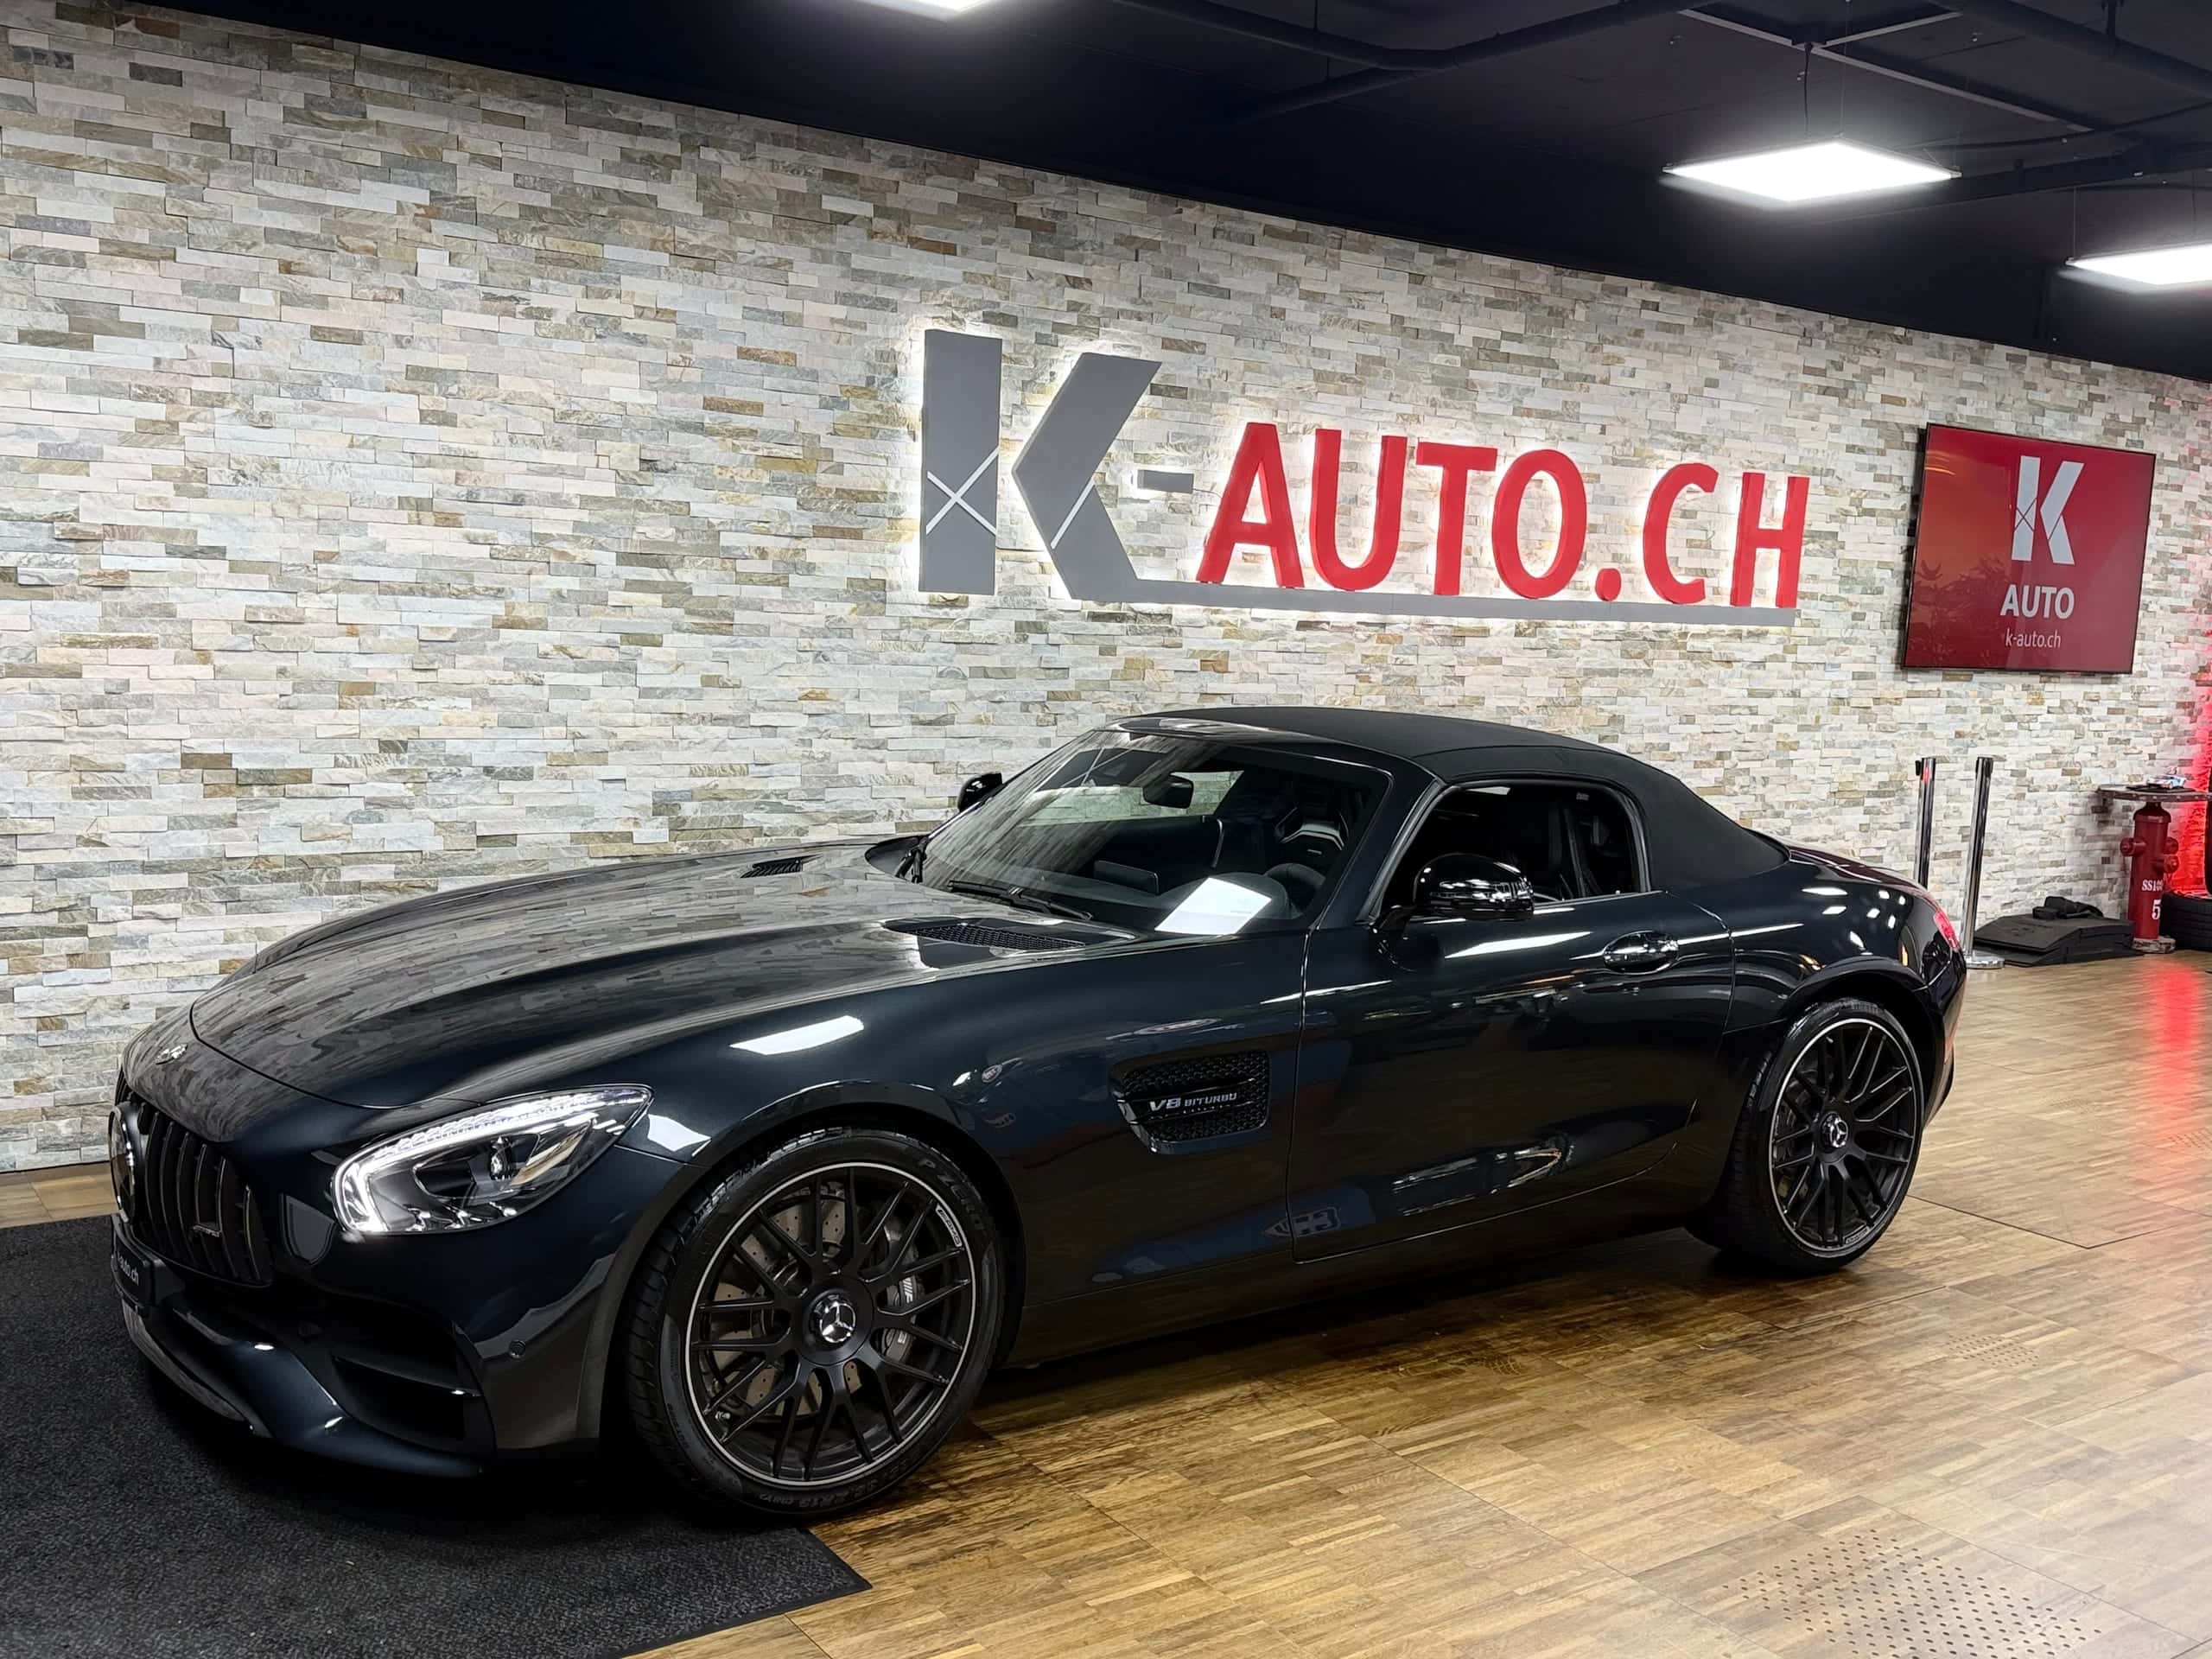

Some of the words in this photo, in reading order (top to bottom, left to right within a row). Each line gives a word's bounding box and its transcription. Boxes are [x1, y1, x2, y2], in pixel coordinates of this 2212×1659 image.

[918, 328, 1810, 609] K-AUTO.CH
[2012, 455, 2085, 566] K
[1999, 583, 2075, 620] AUTO
[2005, 627, 2062, 648] k-auto.ch
[1148, 1096, 1182, 1112] V8
[1184, 1092, 1237, 1107] BITURBO
